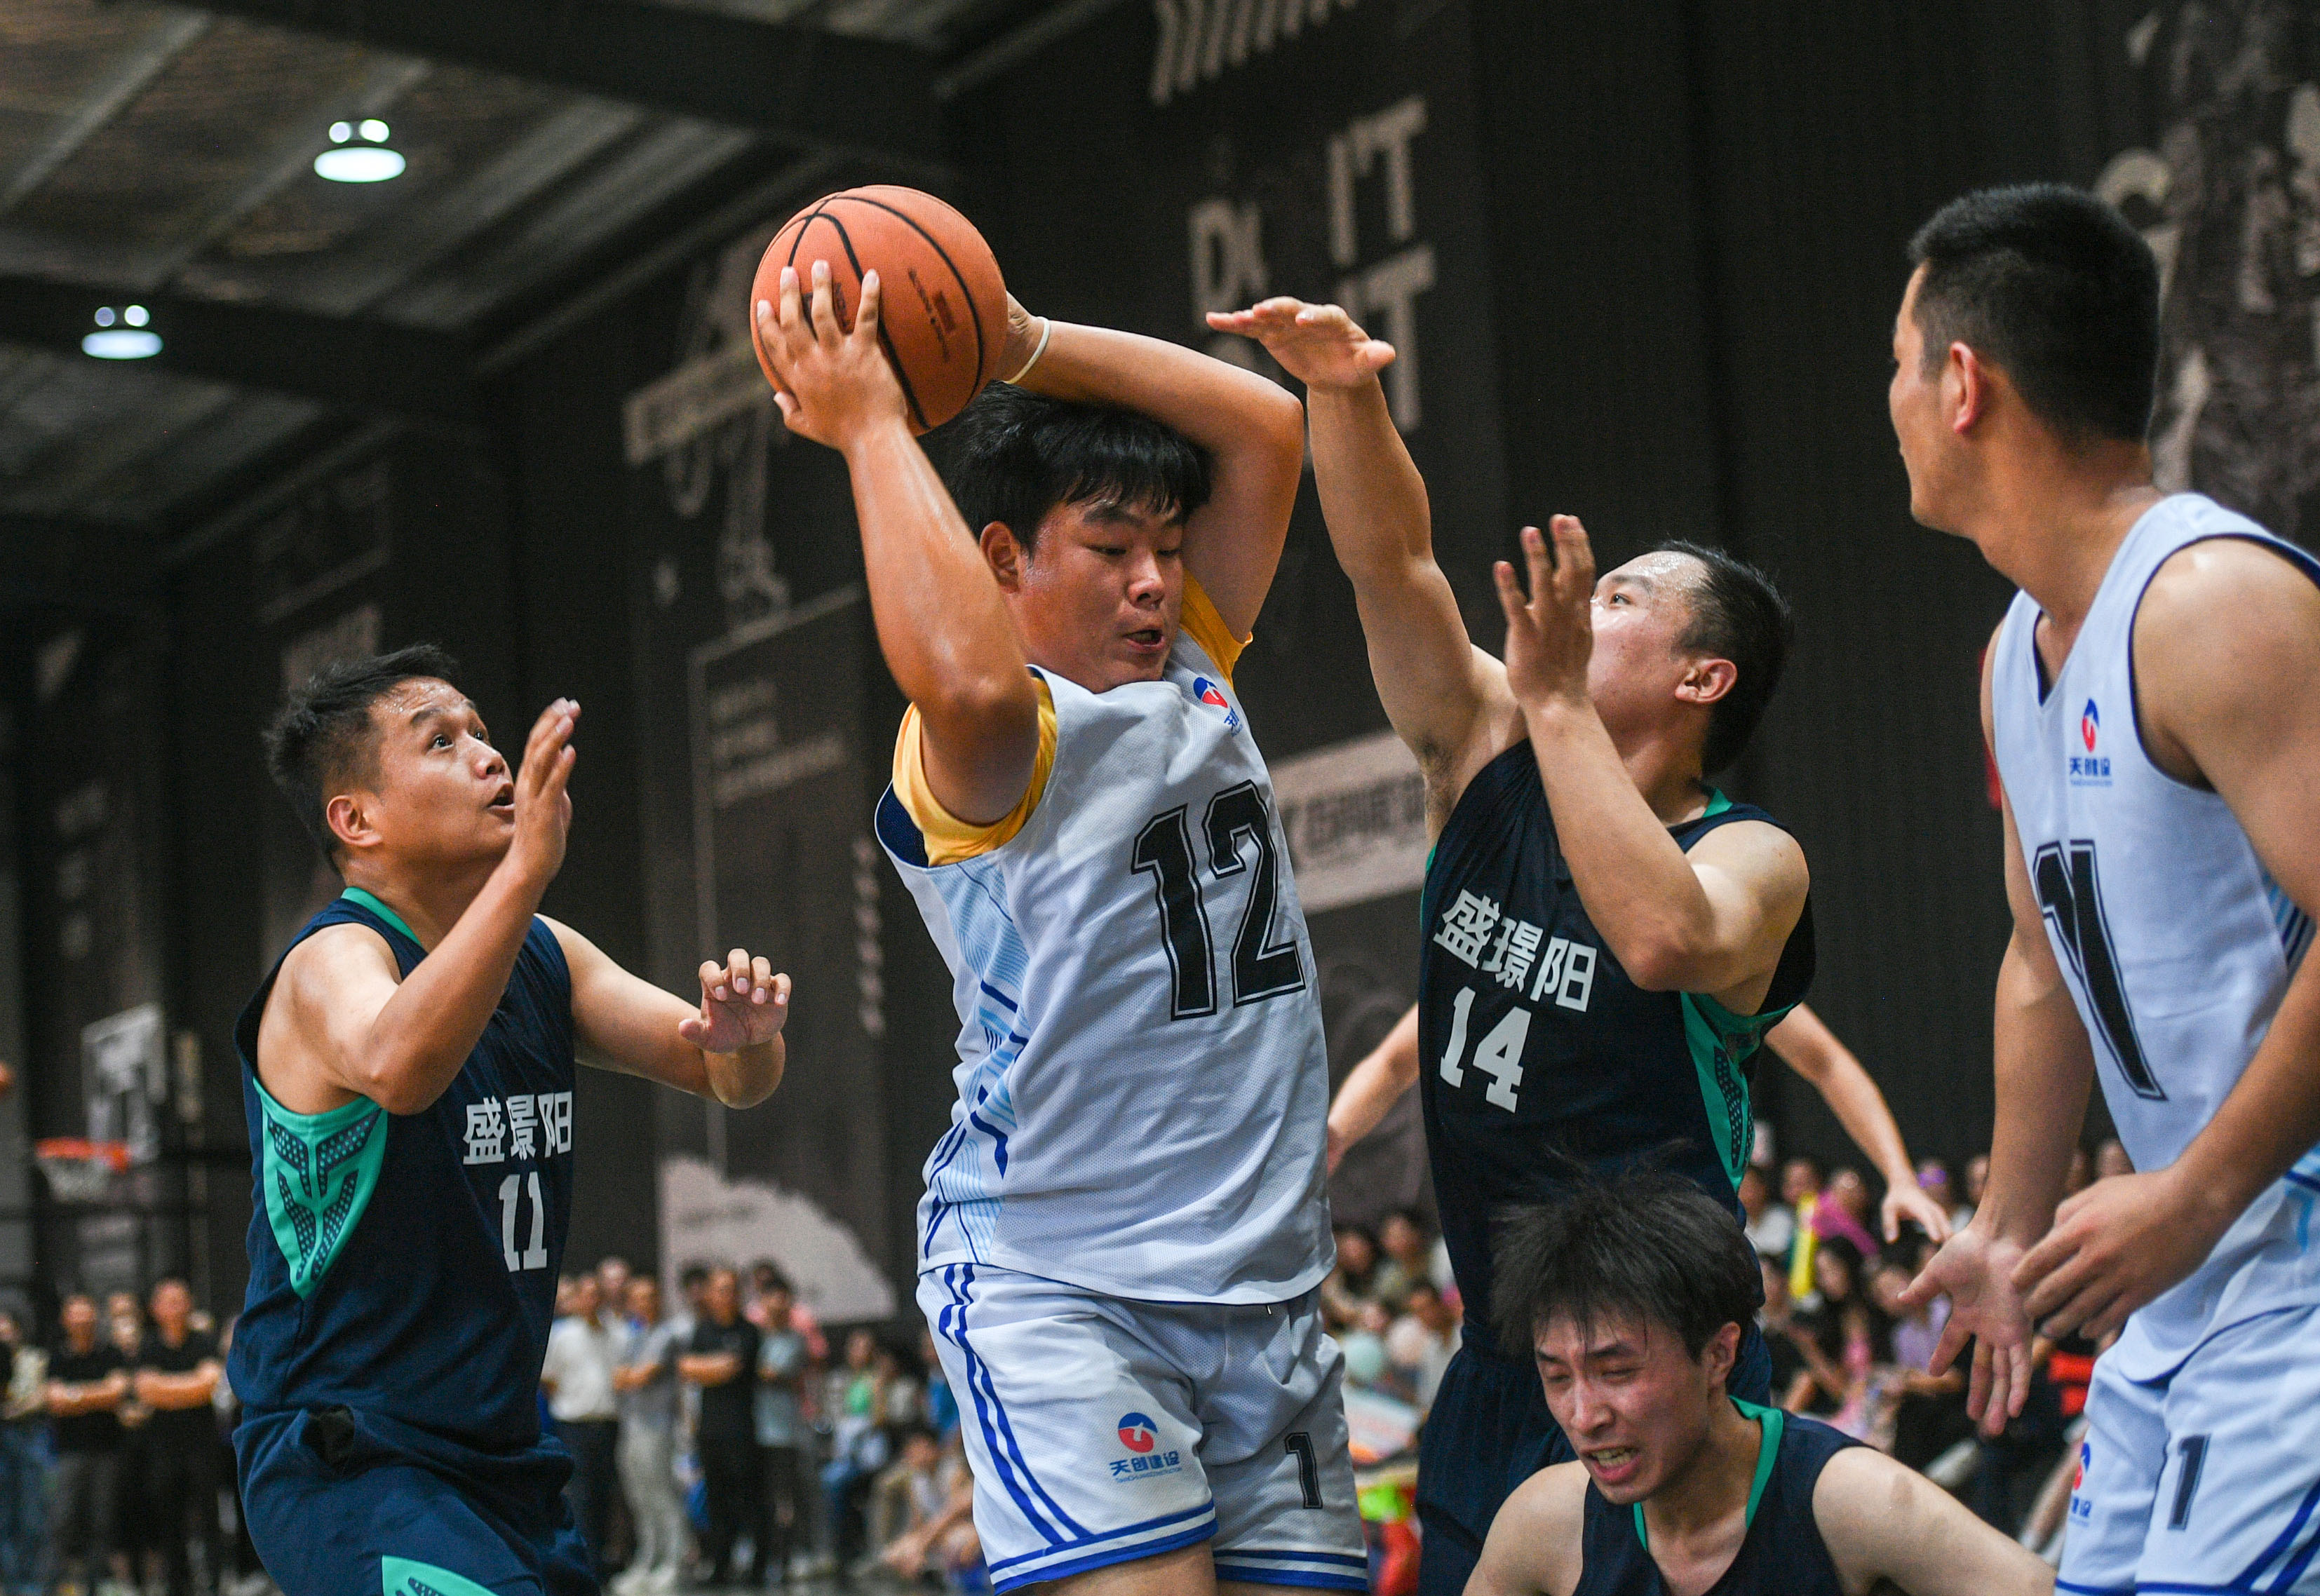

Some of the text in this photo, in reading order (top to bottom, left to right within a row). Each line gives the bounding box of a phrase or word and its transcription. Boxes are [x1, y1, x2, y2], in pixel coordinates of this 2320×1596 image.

[1131, 779, 1306, 1022] 12
[1433, 888, 1598, 1013] 盛璟阳
[1440, 986, 1532, 1114] 14
[499, 1171, 547, 1273] 11
[1109, 1450, 1180, 1477] 天创建设
[1284, 1432, 1323, 1509] 1
[2167, 1433, 2211, 1531] 1
